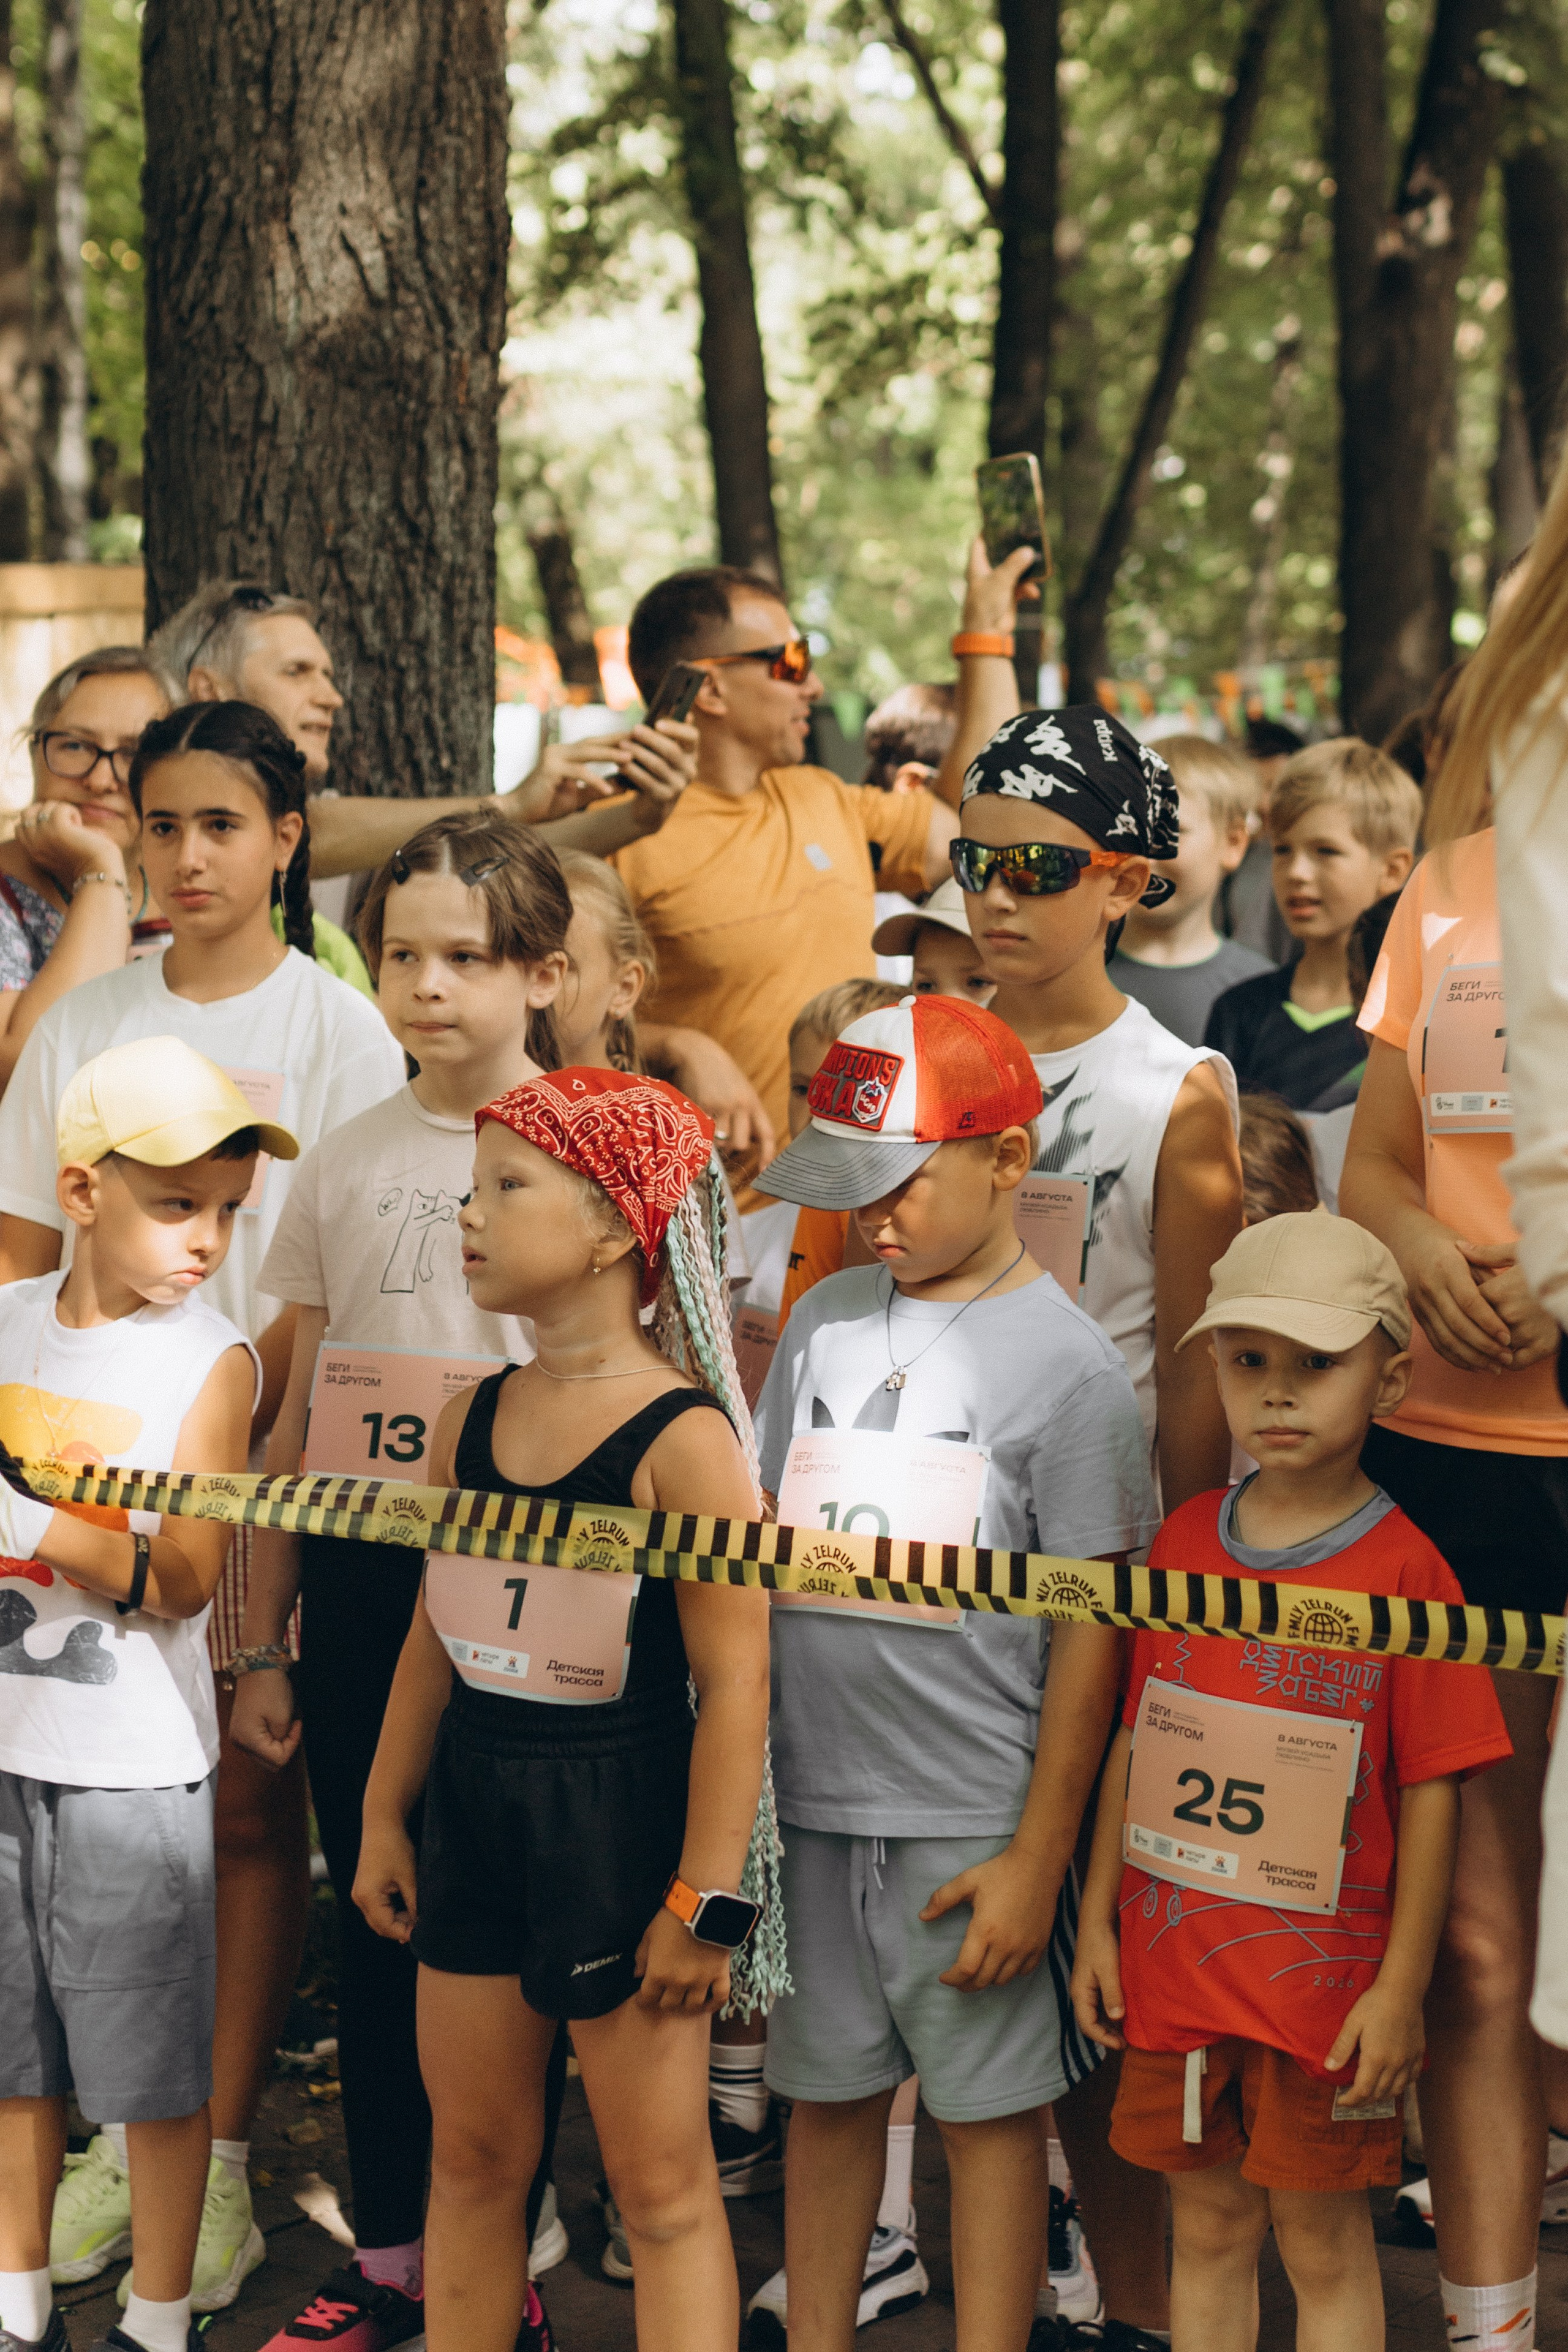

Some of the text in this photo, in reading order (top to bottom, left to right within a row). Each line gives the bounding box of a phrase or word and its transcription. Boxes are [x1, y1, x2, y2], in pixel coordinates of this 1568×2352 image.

[1093, 719, 1118, 762] Kappa
[1450, 981, 1481, 991] БЕГИ
[1446, 992, 1505, 1003] ЗА ДРУГО
[1030, 1192, 1073, 1202] АВГУСТА
[326, 1362, 350, 1373] БЕГИ
[338, 1375, 382, 1387] ДРУГОМ
[362, 1412, 426, 1463] 13
[794, 1451, 813, 1461] БЕГИ
[590, 1518, 630, 1547] ZELRUN
[812, 1544, 858, 1574] ZELRUN
[1048, 1570, 1098, 1599] ZELRUN
[503, 1577, 529, 1630] 1
[1287, 1604, 1305, 1639] FMLY
[1300, 1598, 1354, 1624] ZELRUN
[546, 1659, 605, 1678] Детская
[553, 1674, 603, 1687] трасса
[1148, 1702, 1171, 1718] БЕГИ
[1145, 1715, 1158, 1728] ЗА
[1158, 1719, 1204, 1742] ДРУГОМ
[1287, 1736, 1338, 1751] АВГУСТА
[1173, 1768, 1265, 1836] 25
[1257, 1860, 1318, 1880] Детская
[1265, 1874, 1316, 1891] трасса
